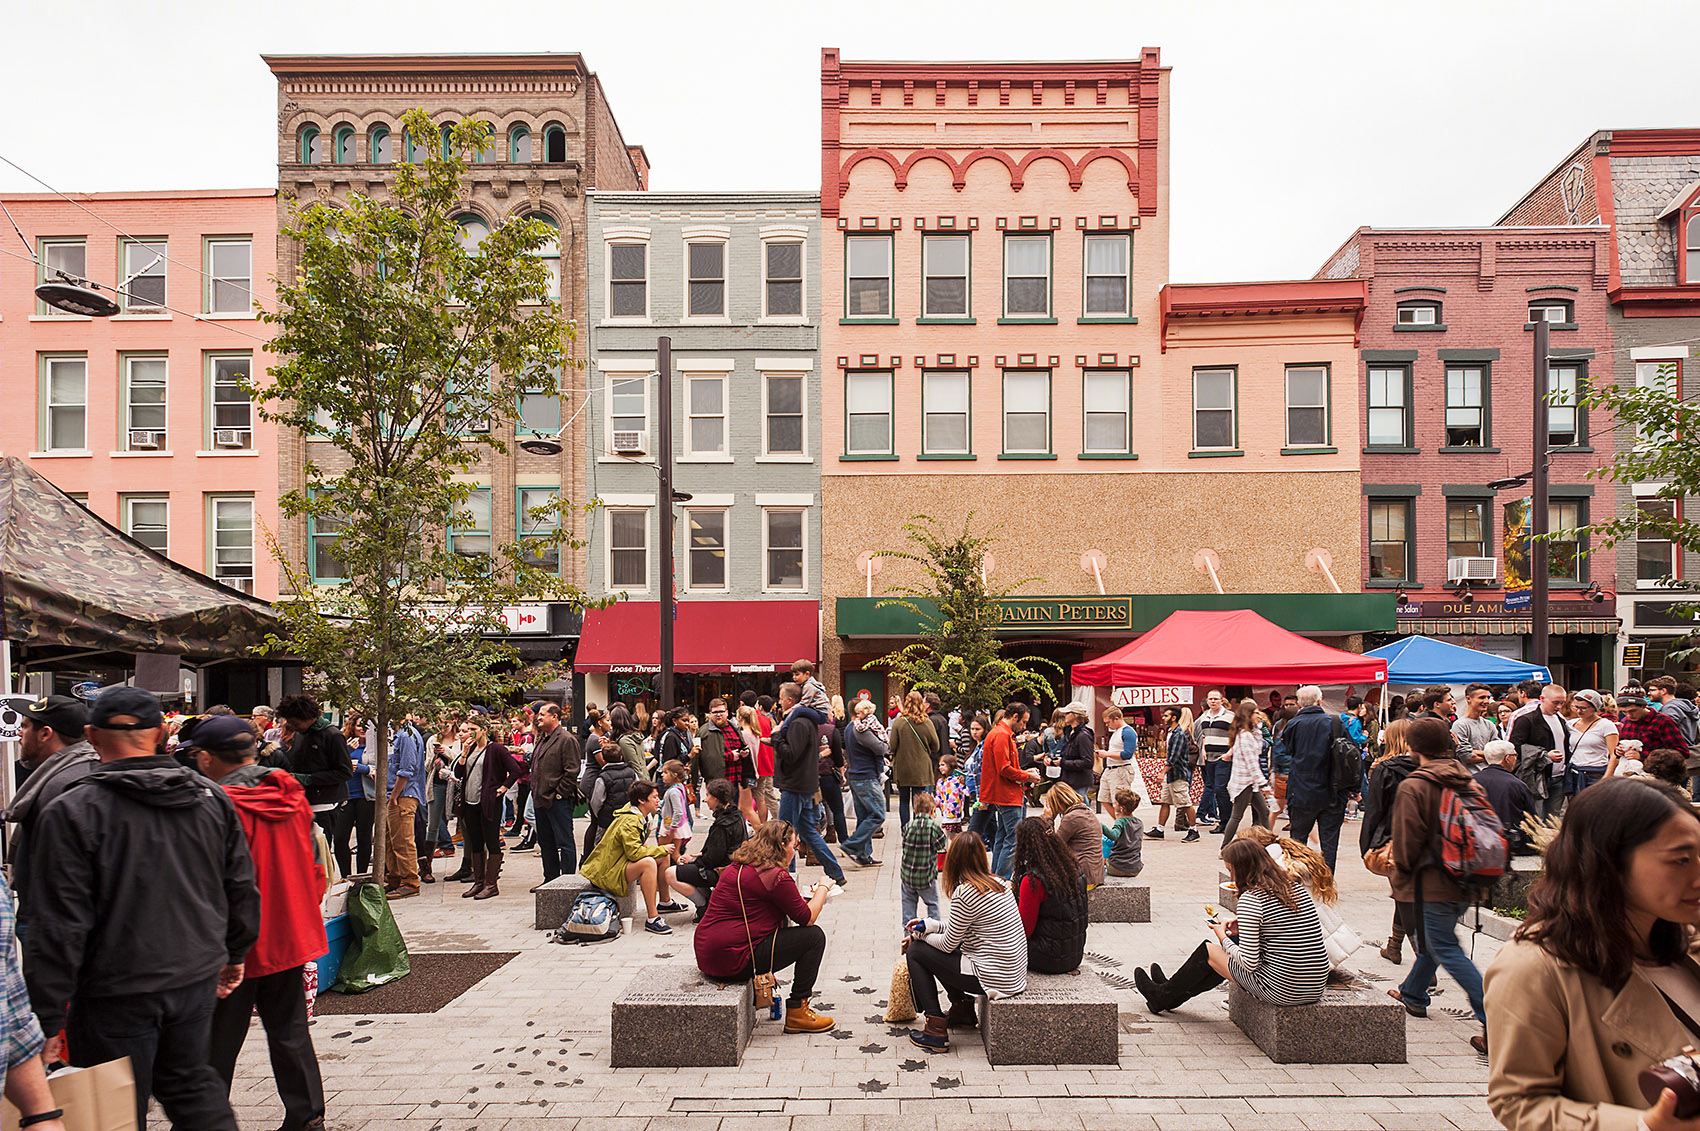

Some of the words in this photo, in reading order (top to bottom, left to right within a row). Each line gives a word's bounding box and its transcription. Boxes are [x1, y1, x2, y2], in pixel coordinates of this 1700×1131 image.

[963, 605, 1053, 623] EJAMIN
[1057, 603, 1127, 620] PETERS
[1404, 603, 1419, 613] Salon
[1443, 604, 1472, 614] DUE
[609, 664, 633, 672] Loose
[634, 664, 662, 673] Thread
[1117, 687, 1180, 705] APPLES
